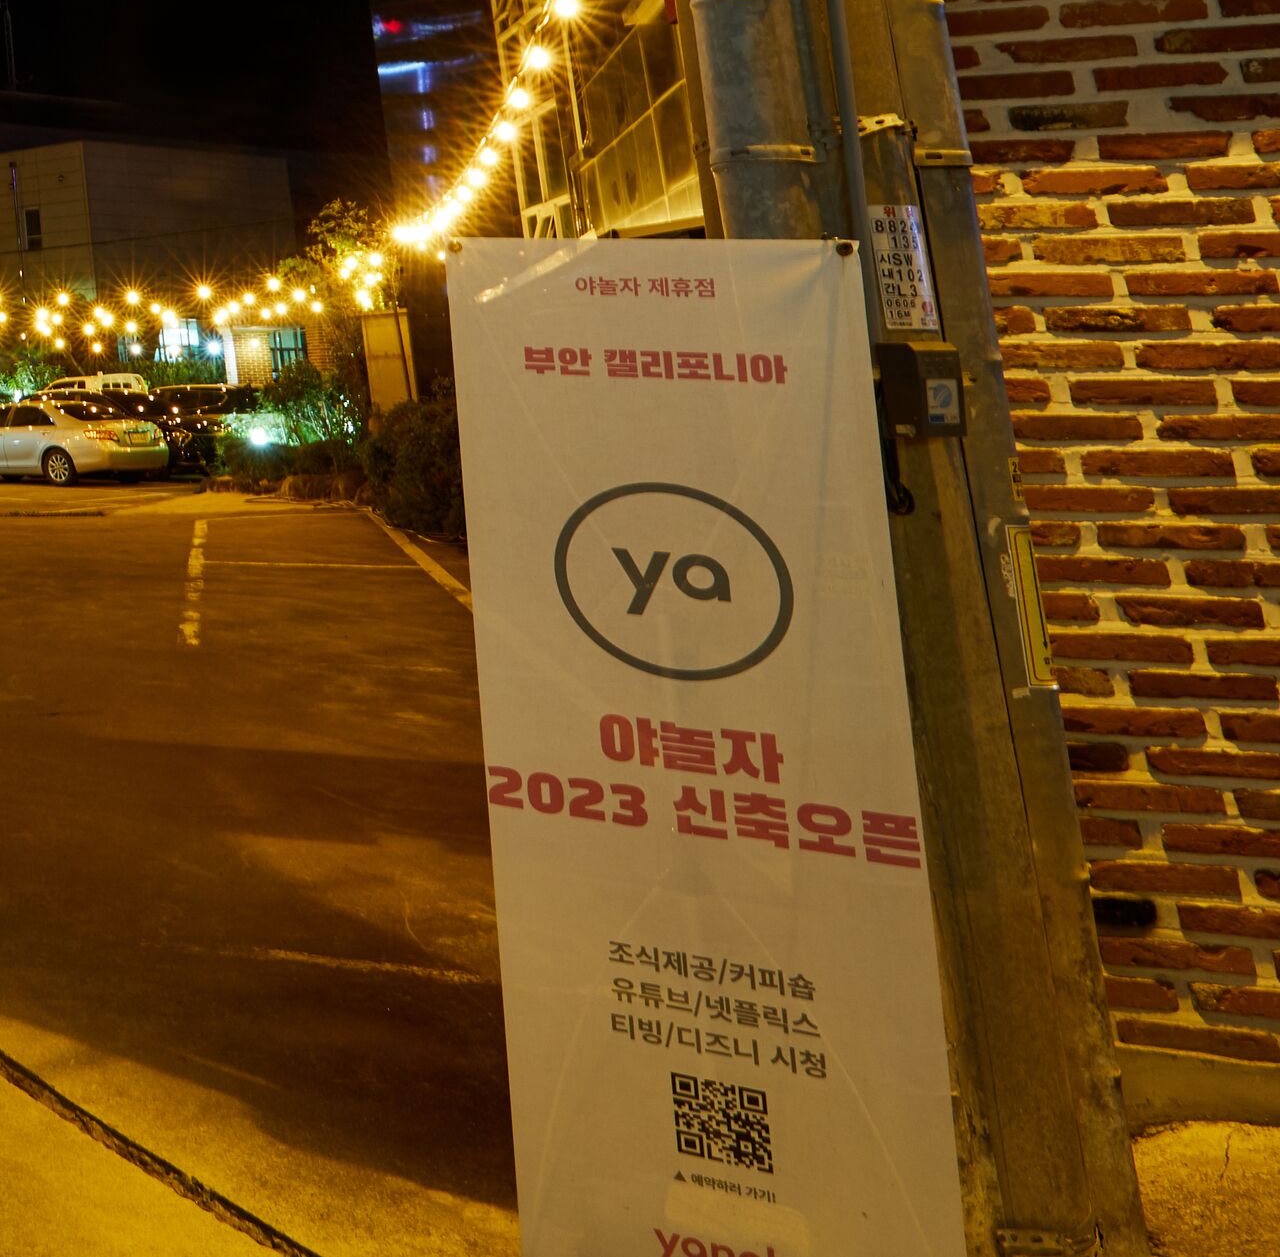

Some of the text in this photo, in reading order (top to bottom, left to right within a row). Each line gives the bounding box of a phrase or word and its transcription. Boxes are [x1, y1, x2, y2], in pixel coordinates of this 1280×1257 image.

[890, 235, 919, 250] 135
[575, 276, 716, 298] 야놀자 제휴점
[523, 346, 788, 384] 부안 캘리포니아
[610, 546, 732, 616] ya
[598, 712, 784, 785] 야놀자
[487, 765, 922, 869] 2023 신축오픈
[608, 940, 816, 1001] 조식제공/커피숍
[611, 976, 821, 1038] 유튜브/넷플릭스
[610, 1012, 827, 1080] 티빙/디즈니 시청
[690, 1172, 777, 1204] 예약하러 가기!
[653, 1227, 776, 1257] yan
